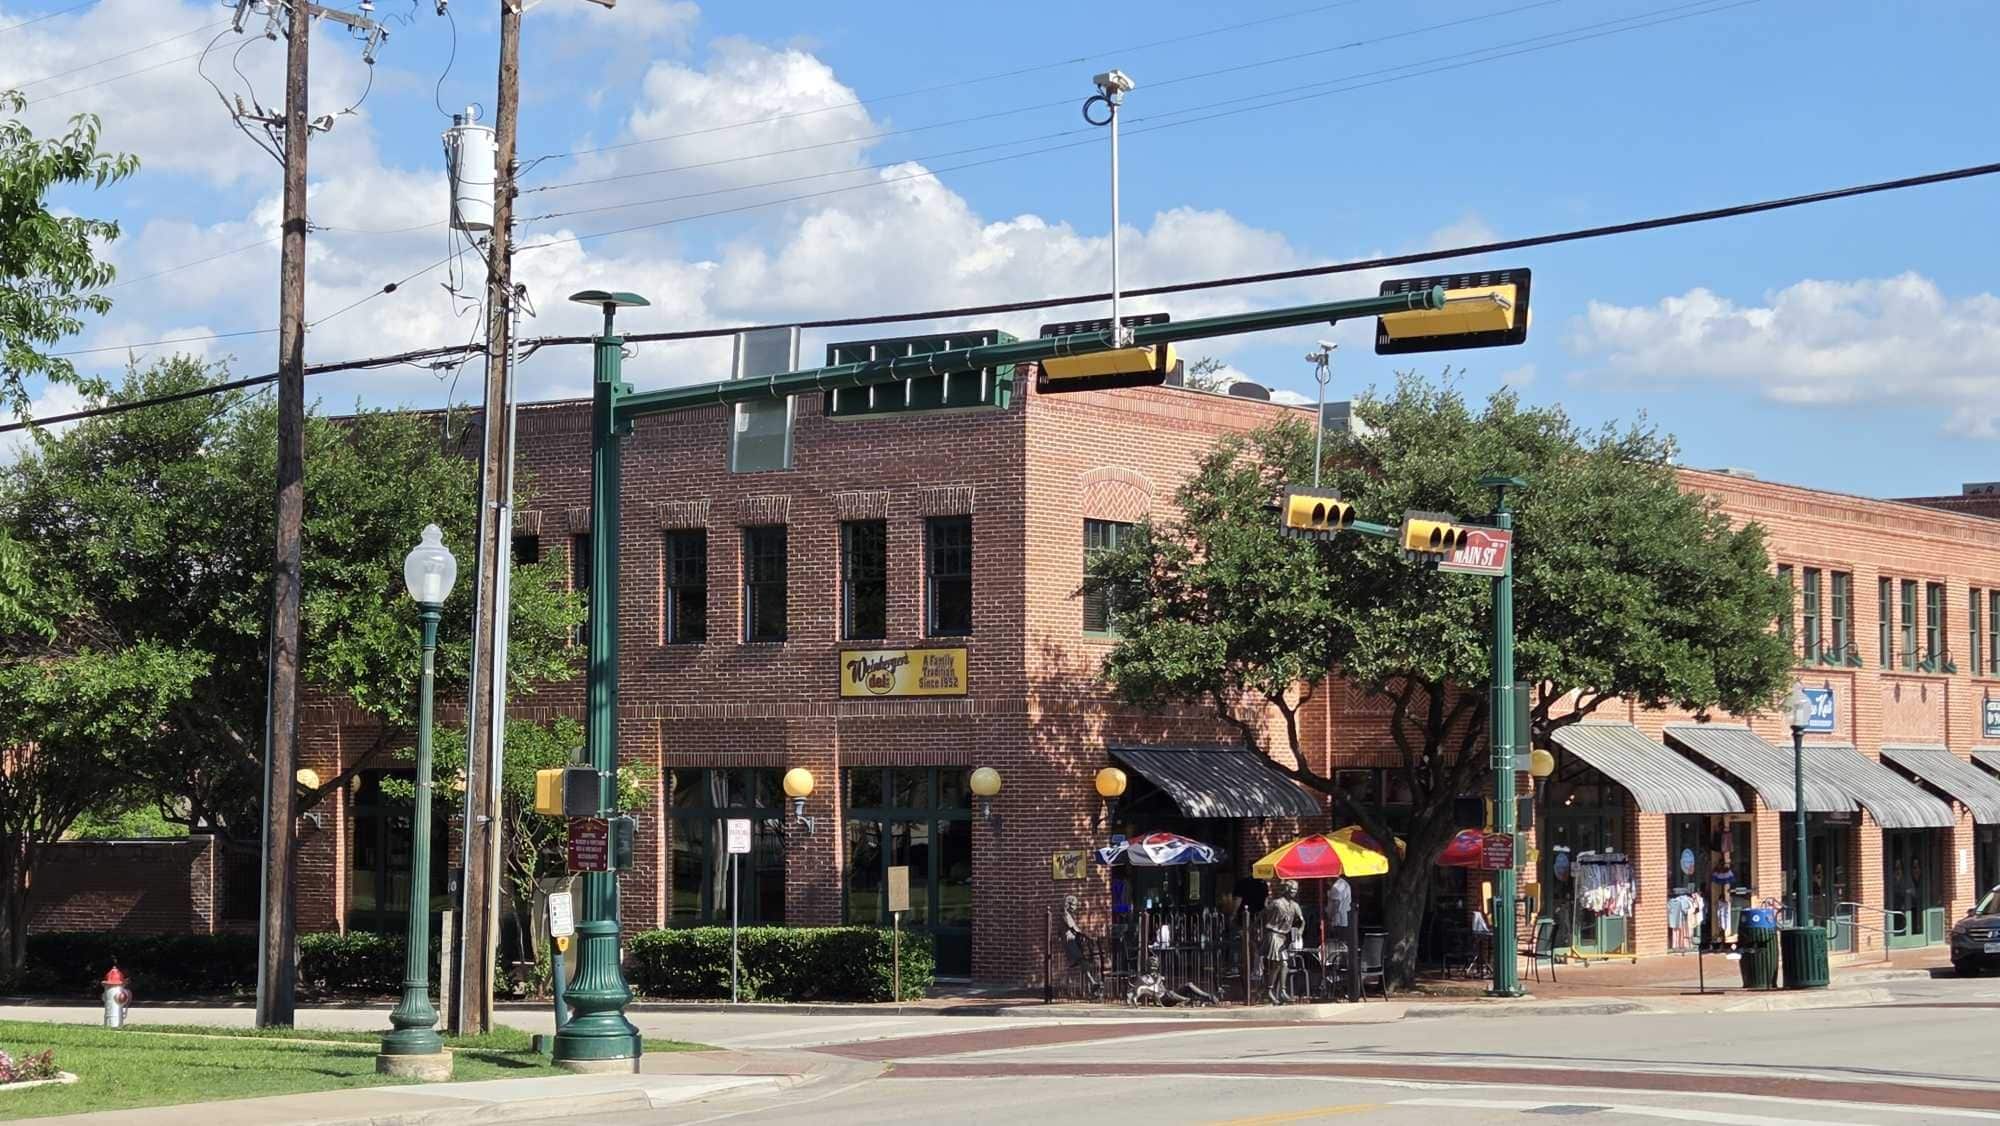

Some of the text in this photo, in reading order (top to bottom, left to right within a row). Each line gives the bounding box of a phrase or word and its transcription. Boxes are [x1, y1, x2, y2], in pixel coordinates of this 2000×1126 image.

[1453, 545, 1497, 566] MAIN ST
[923, 655, 954, 667] A Family
[922, 667, 955, 677] Tradition
[869, 672, 889, 688] deli
[918, 677, 959, 688] Since 1952
